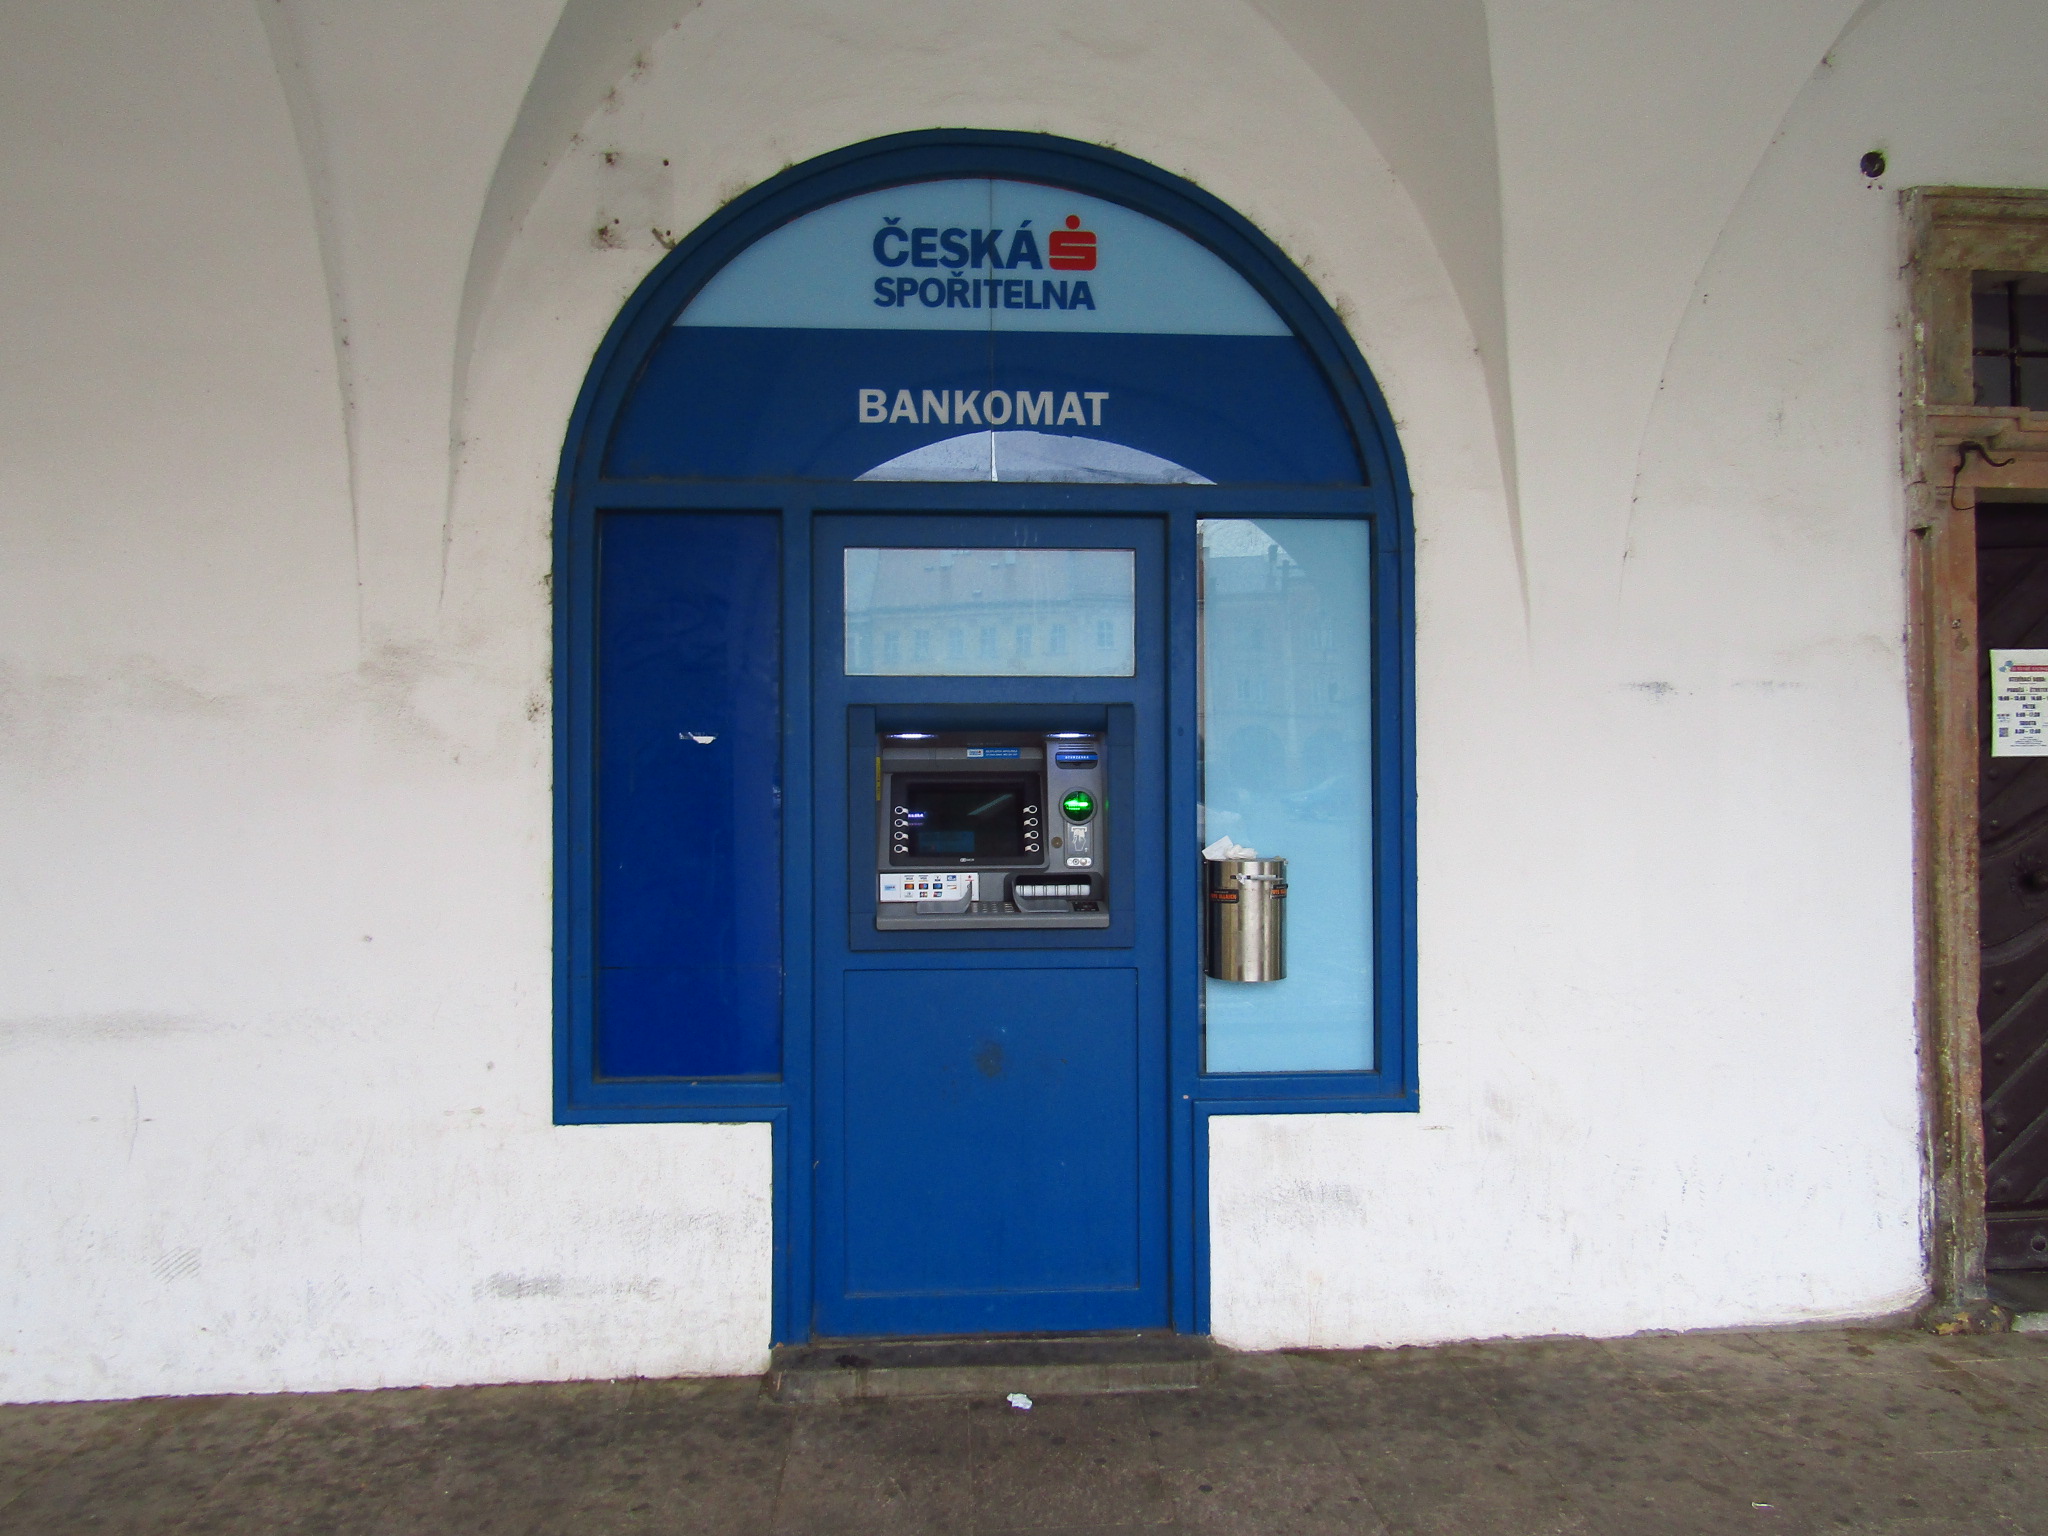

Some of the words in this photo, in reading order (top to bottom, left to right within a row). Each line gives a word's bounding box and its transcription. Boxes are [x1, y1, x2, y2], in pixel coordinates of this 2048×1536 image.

[873, 216, 1043, 270] ČESKÁ
[873, 271, 1096, 311] SPOŘITELNA
[858, 388, 1110, 426] BANKOMAT
